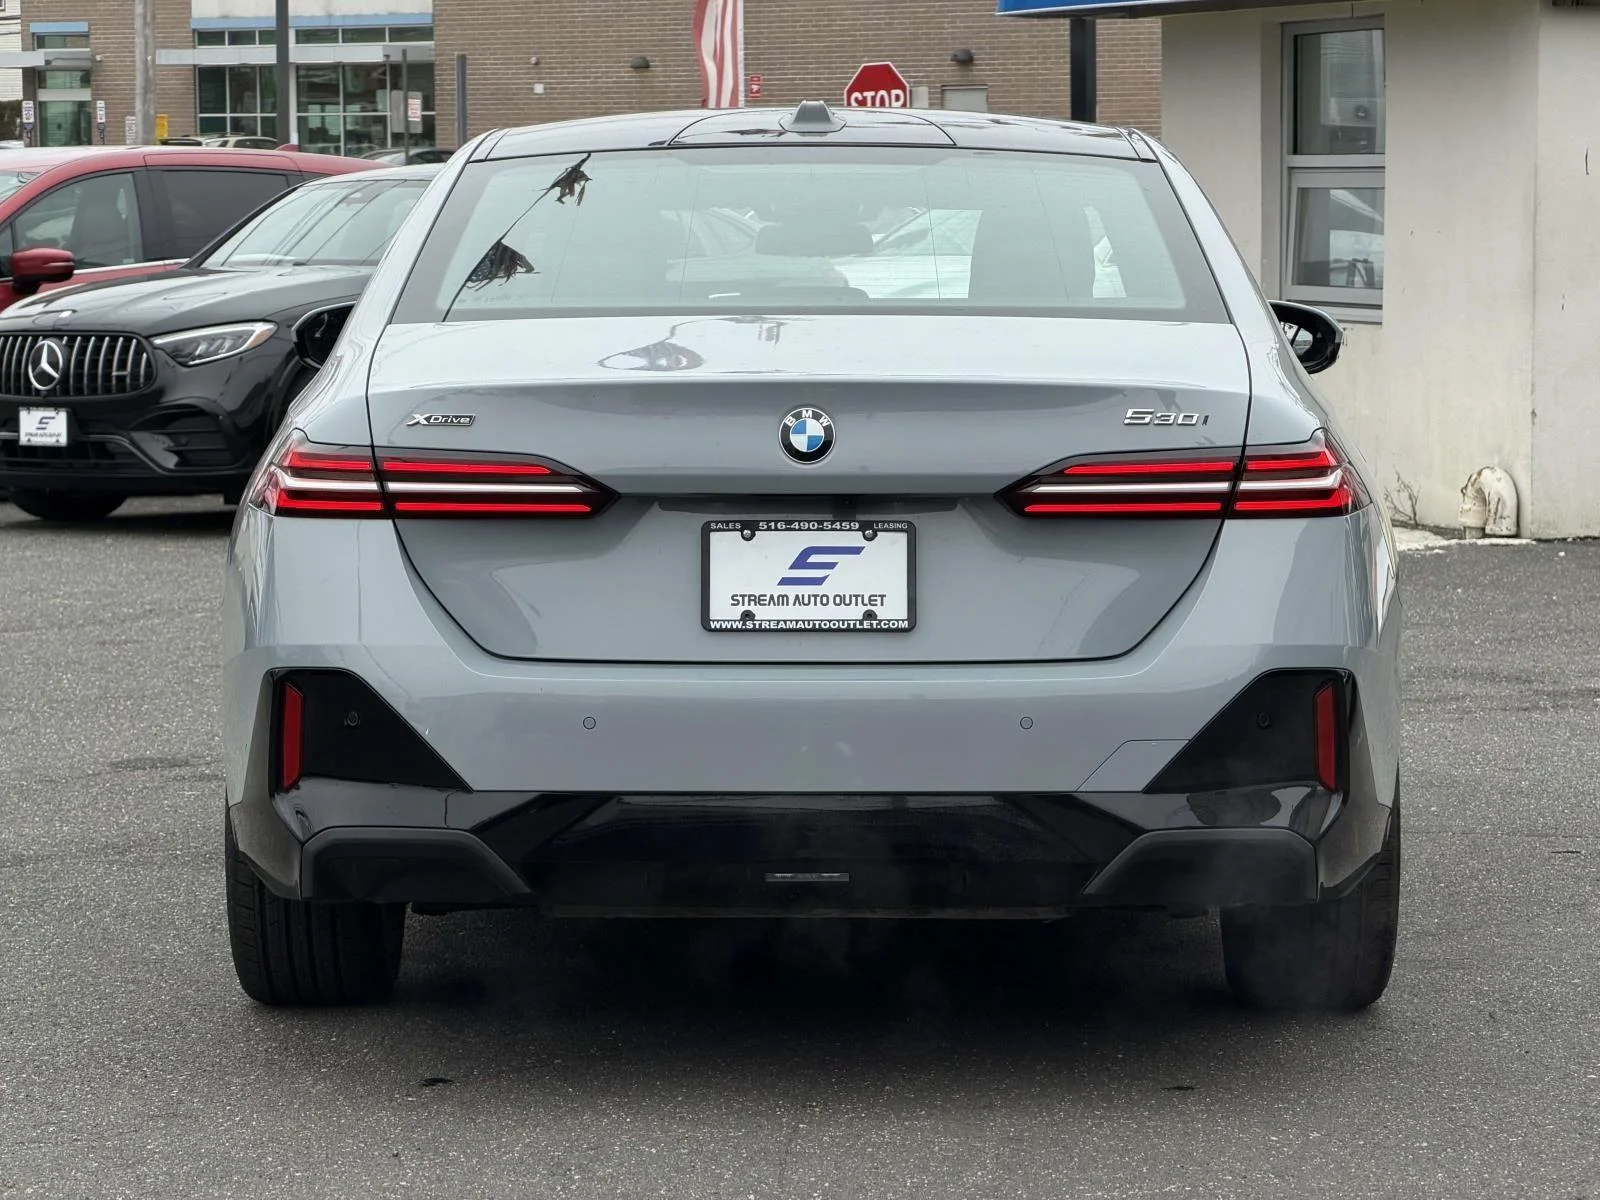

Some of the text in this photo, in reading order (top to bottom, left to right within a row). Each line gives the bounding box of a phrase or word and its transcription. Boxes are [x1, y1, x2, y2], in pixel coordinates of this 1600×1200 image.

[851, 89, 904, 107] STOP
[784, 409, 831, 427] BMW
[758, 521, 860, 530] 516-490-5459
[730, 594, 886, 606] STREAM AUTO OUTLET
[710, 620, 908, 629] WWW.STREAMAUTOOUTLET.COM
